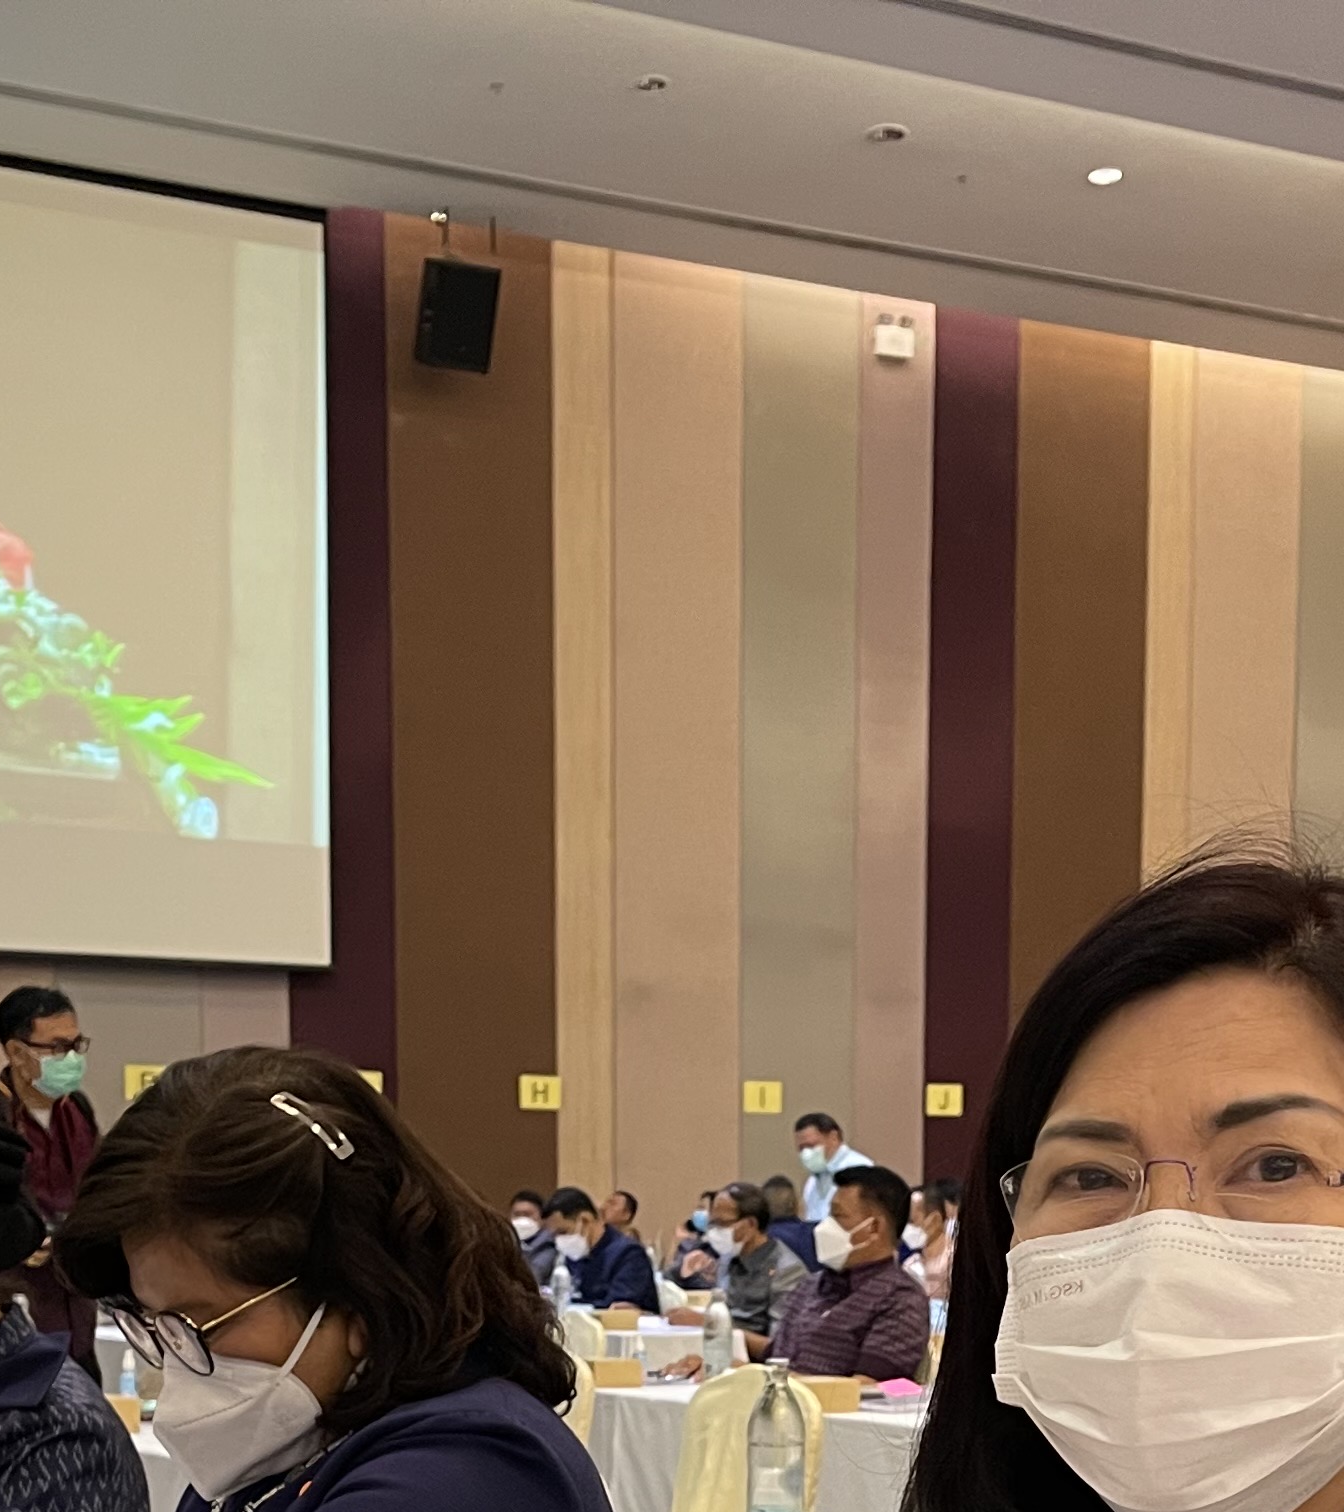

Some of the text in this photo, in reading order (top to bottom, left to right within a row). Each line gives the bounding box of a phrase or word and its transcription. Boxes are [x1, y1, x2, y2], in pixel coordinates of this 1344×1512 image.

[530, 1081, 549, 1104] H
[758, 1086, 766, 1109] I
[937, 1090, 950, 1110] J
